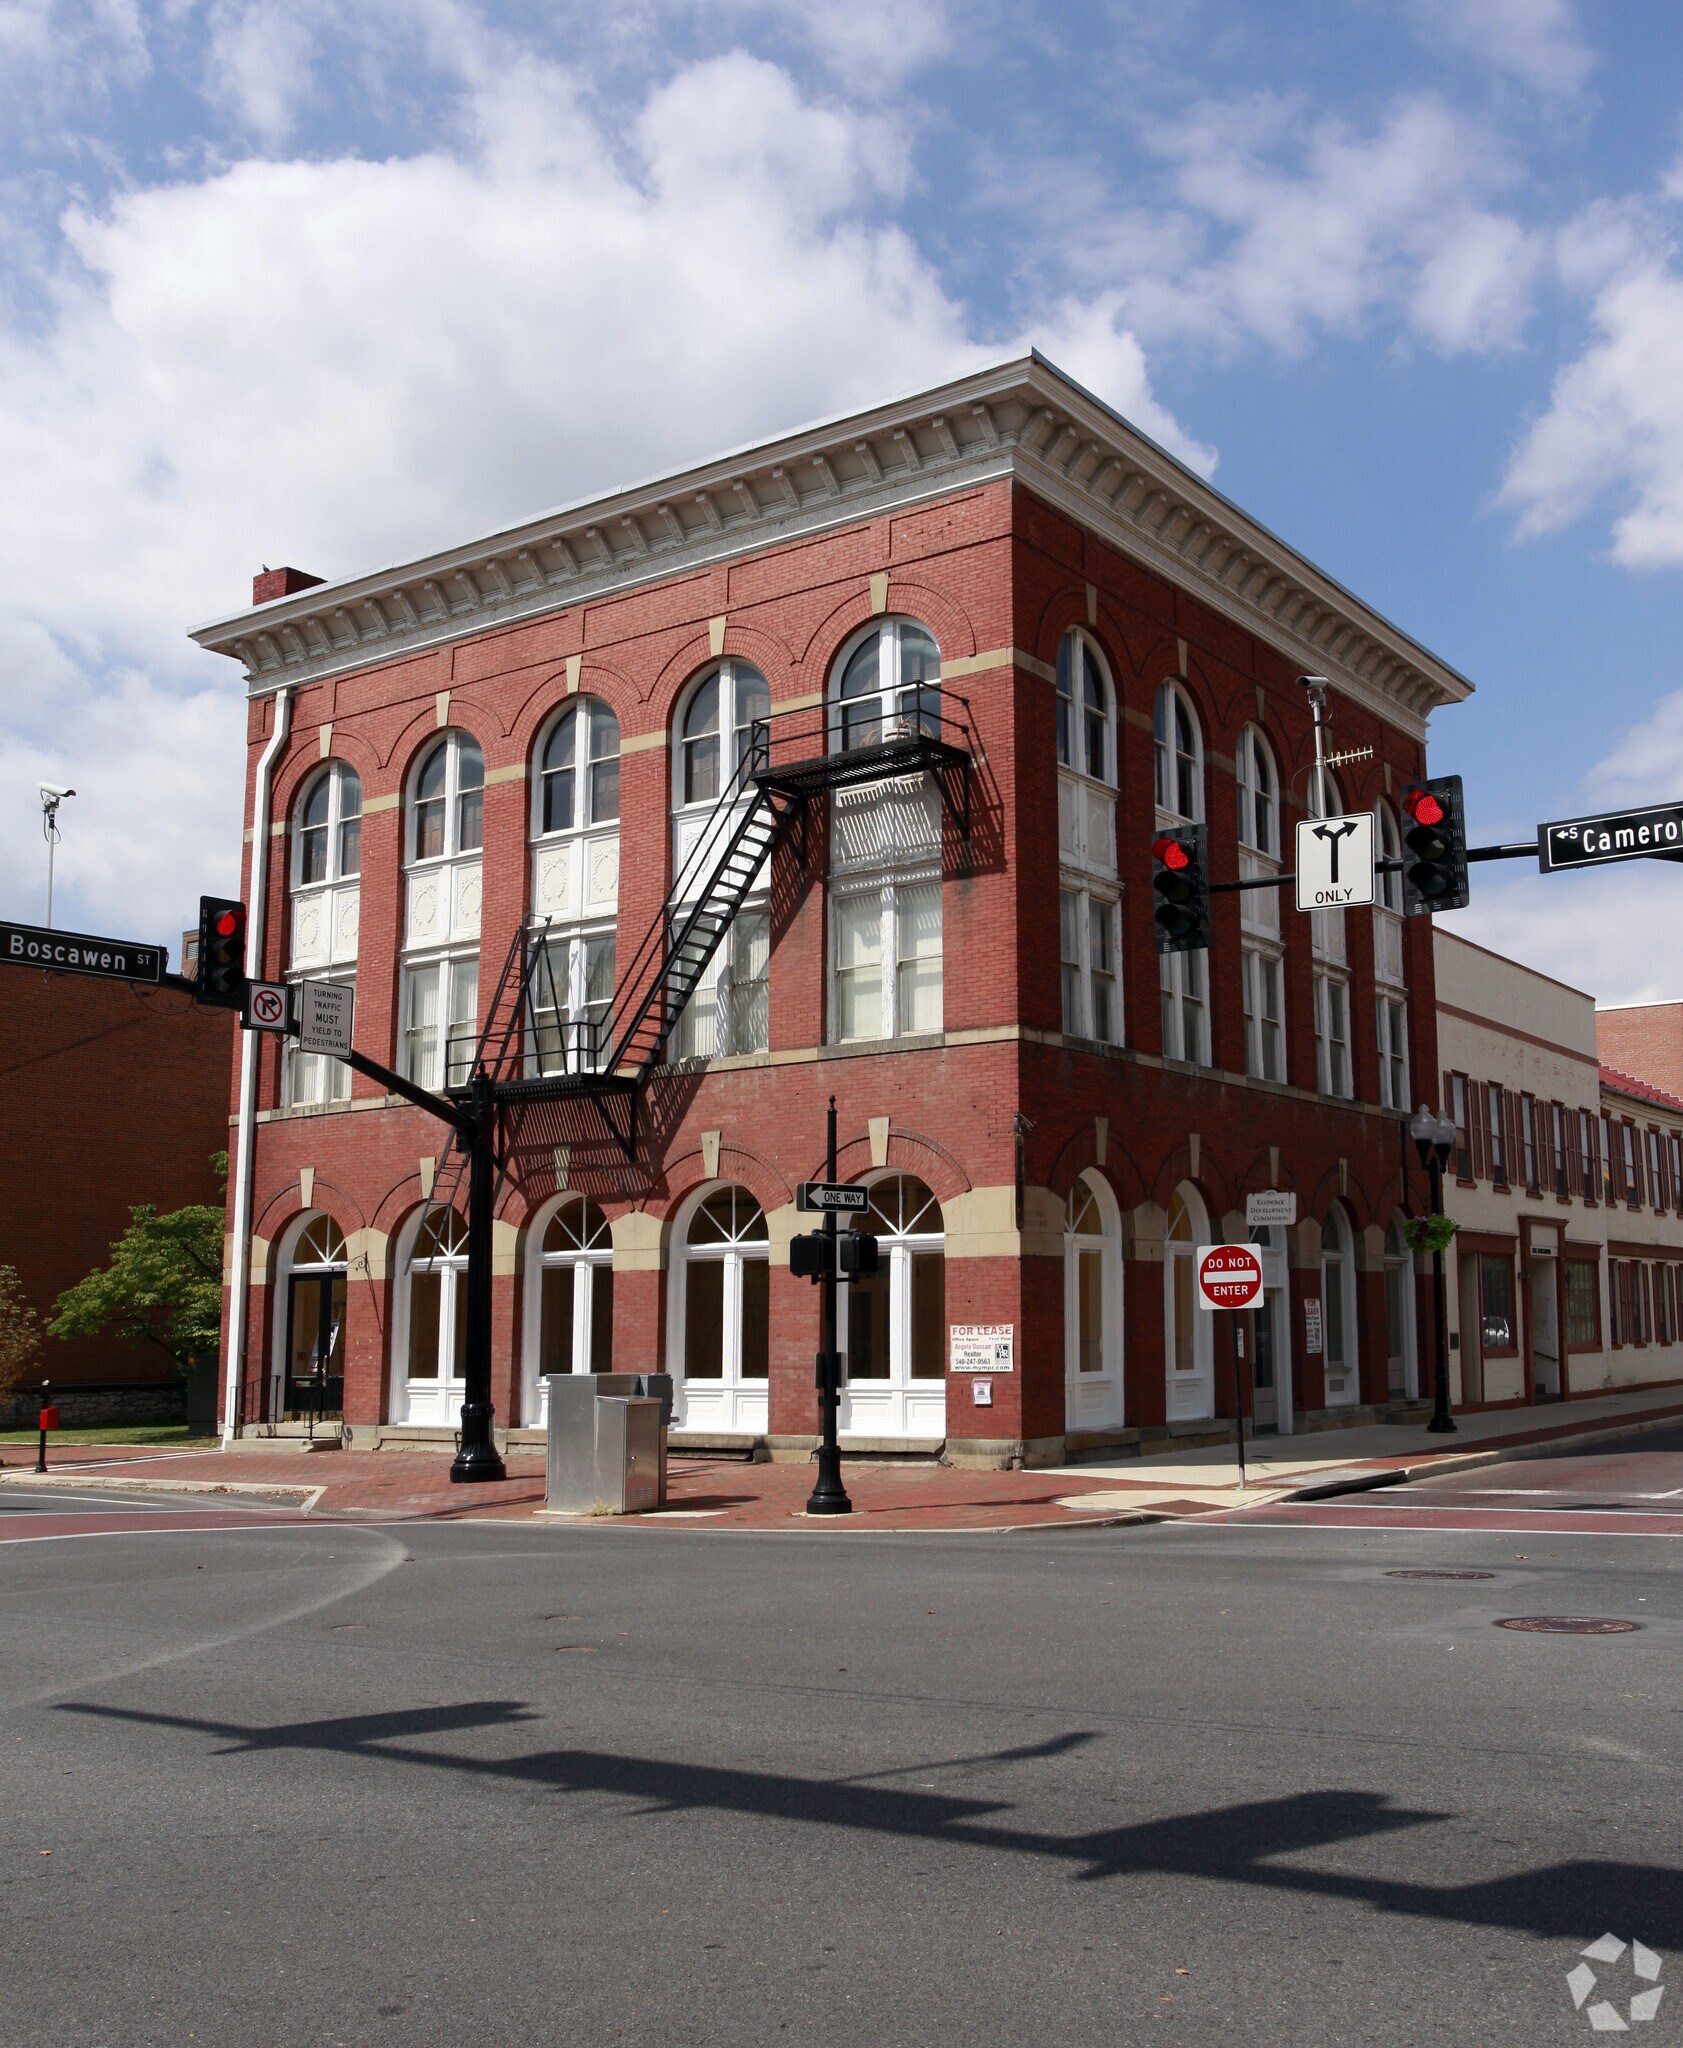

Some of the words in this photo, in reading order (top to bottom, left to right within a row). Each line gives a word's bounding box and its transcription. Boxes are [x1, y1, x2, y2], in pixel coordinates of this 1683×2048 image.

[1569, 827, 1579, 839] S
[1583, 820, 1683, 853] Camero
[1315, 888, 1353, 904] ONLY
[9, 934, 126, 971] Boscawen
[137, 954, 151, 965] ST
[314, 989, 343, 1001] TURNING
[314, 1001, 342, 1012] TRAFFIC
[315, 1013, 339, 1025] MUST
[311, 1025, 332, 1035] YIELD
[334, 1029, 342, 1037] TO
[303, 1036, 348, 1050] PEDESTRIANS
[824, 1191, 841, 1203] ONE
[843, 1192, 862, 1204] WAY
[1208, 1258, 1224, 1269] DO
[1228, 1257, 1251, 1268] NOT
[1213, 1285, 1249, 1296] ENTER
[952, 1327, 974, 1336] FOR
[977, 1326, 1012, 1335] LEASE
[954, 1343, 972, 1351] Angela
[963, 1350, 982, 1358] Realtor
